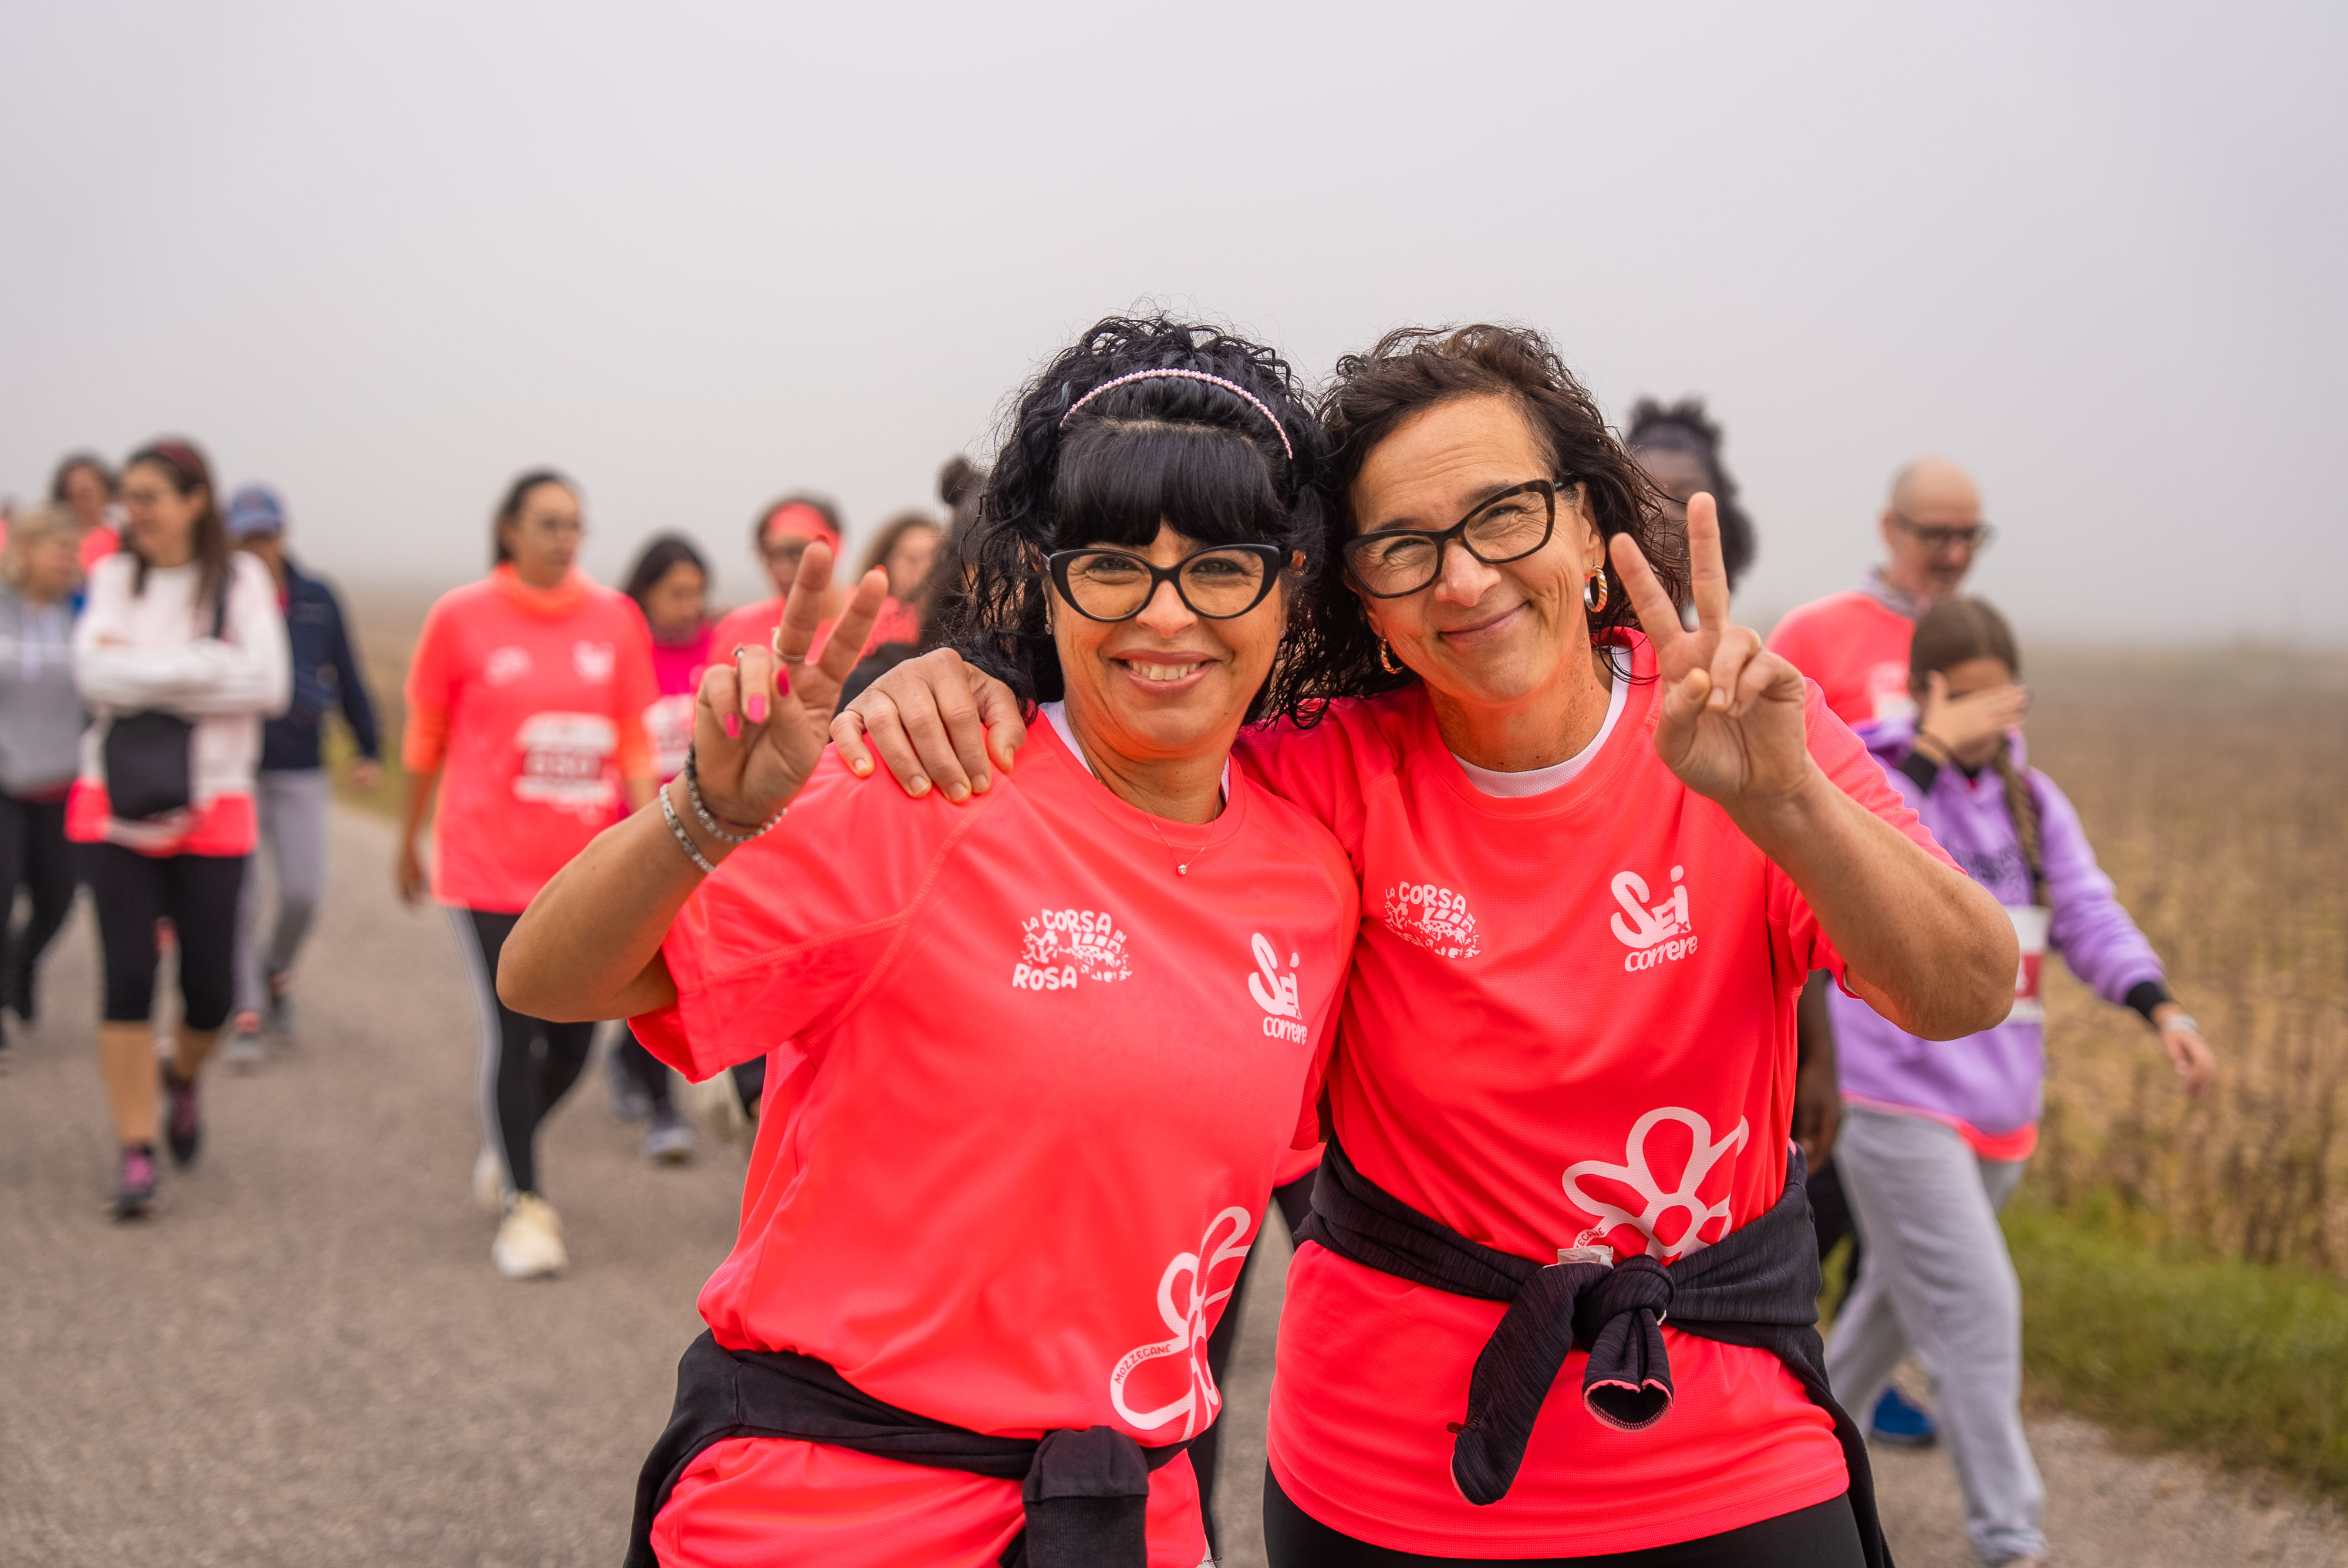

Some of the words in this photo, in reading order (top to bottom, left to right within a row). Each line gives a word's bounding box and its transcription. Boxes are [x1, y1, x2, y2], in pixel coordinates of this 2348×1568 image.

[1385, 887, 1395, 899] LA
[1399, 881, 1466, 915] CORSA
[1021, 917, 1039, 931] LA
[1041, 908, 1112, 935] CORSA
[1467, 913, 1476, 925] IN
[1113, 930, 1126, 943] IN
[1625, 935, 1698, 972] correre
[1013, 963, 1077, 991] ROSA
[1263, 1016, 1307, 1045] correre
[1114, 1344, 1171, 1385] MOZZECANE
